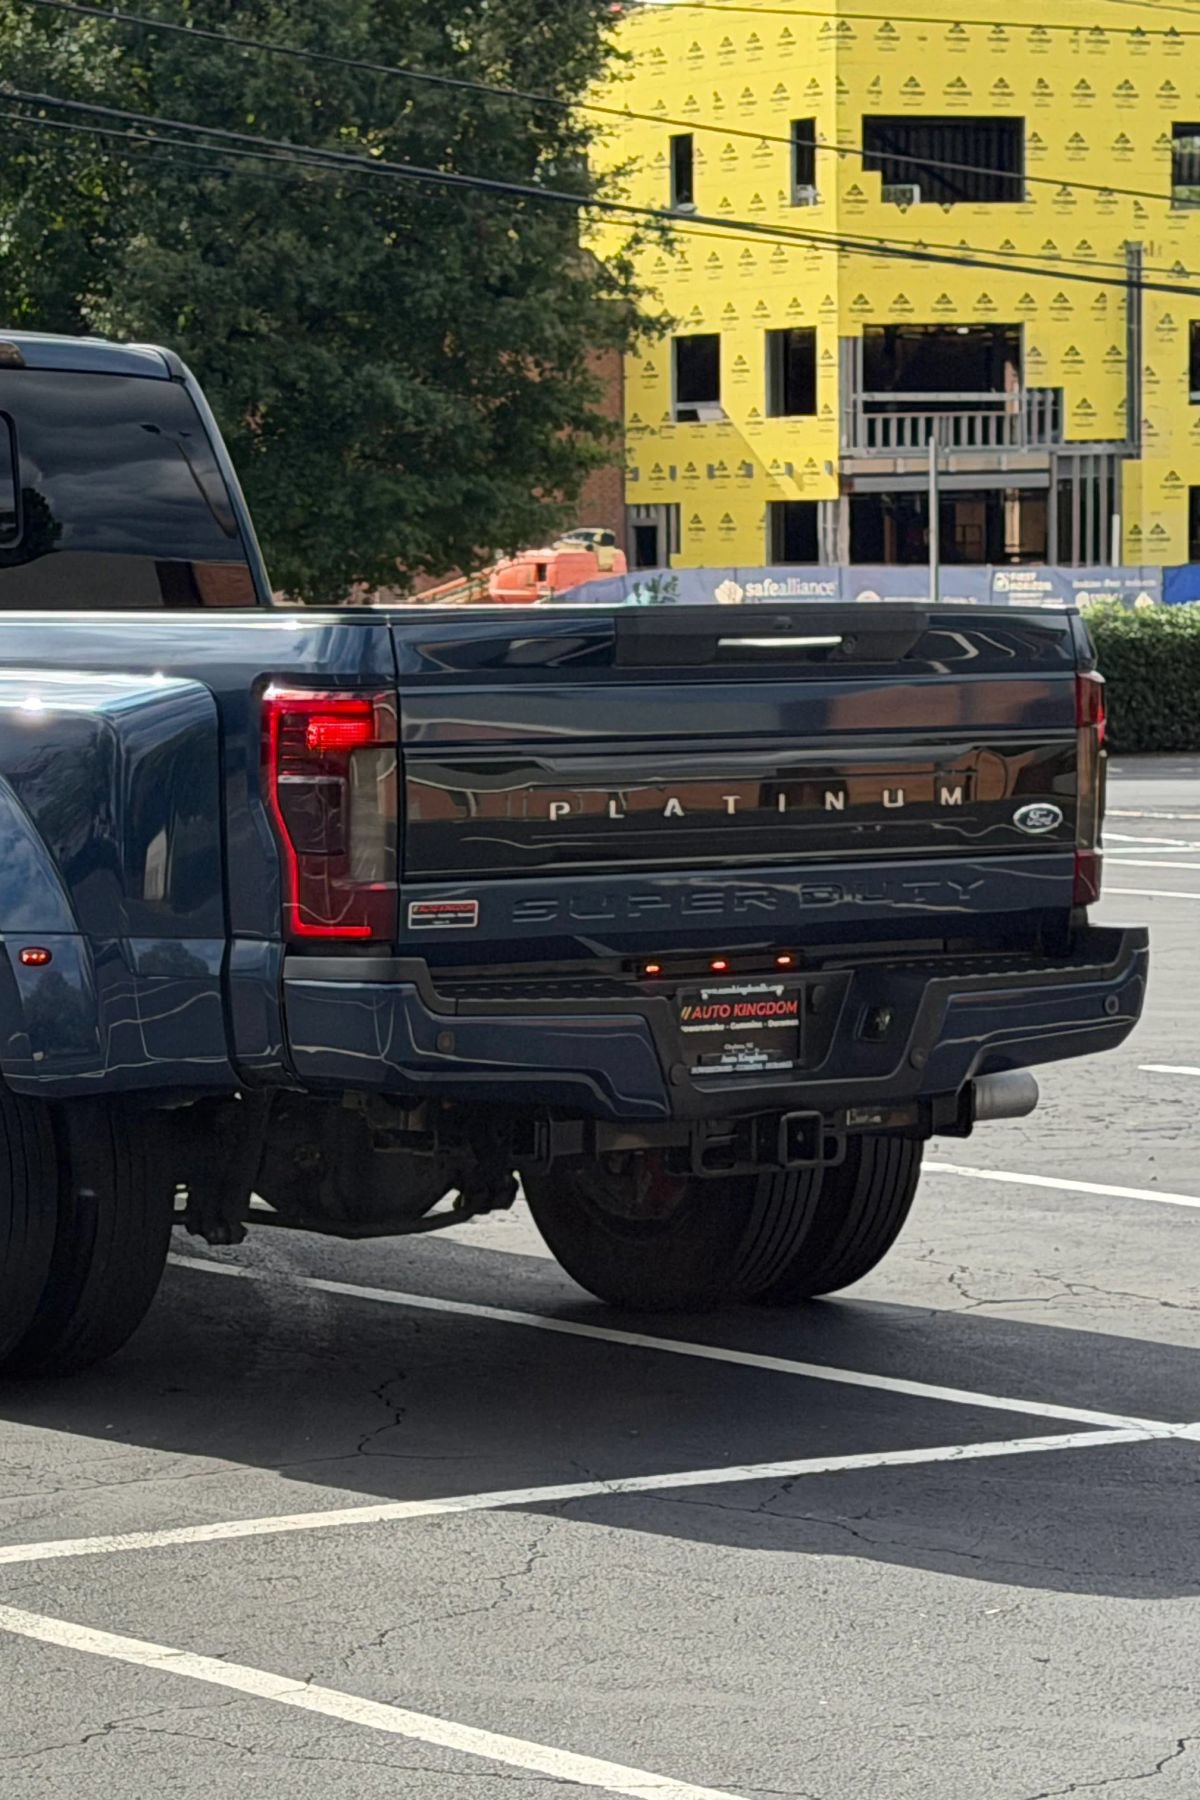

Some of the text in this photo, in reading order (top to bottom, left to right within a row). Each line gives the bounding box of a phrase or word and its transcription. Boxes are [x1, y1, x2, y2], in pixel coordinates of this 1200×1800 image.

[745, 577, 837, 597] safealliance
[549, 785, 963, 821] PLATINUM
[511, 889, 779, 923] SUPER
[691, 1001, 798, 1019] AUTO KINGDOM
